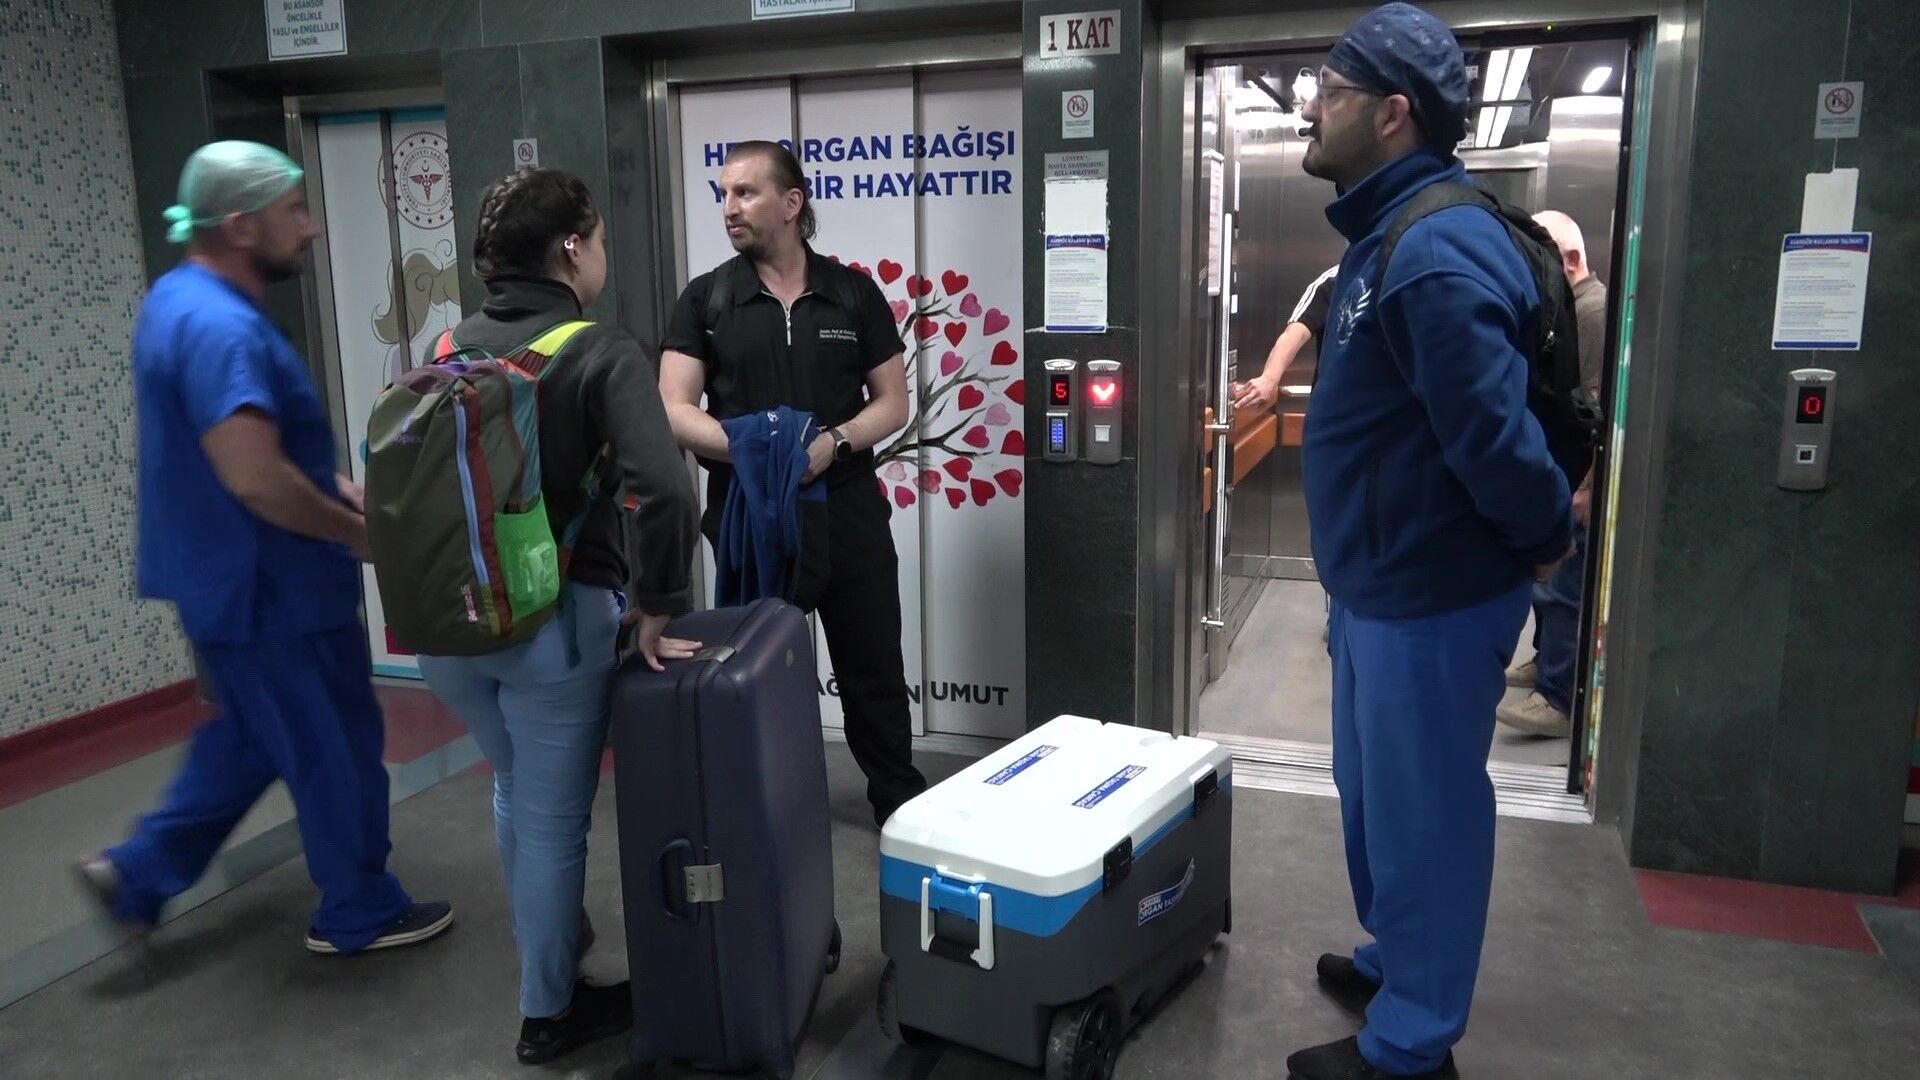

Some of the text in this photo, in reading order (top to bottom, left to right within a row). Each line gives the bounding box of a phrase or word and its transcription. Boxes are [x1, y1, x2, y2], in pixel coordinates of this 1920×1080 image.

[283, 2, 292, 10] BU
[1067, 17, 1114, 50] KAT
[903, 126, 1015, 161] BAĞIŞI
[853, 170, 1013, 198] HAYATTIR
[1055, 383, 1066, 398] 5
[1806, 397, 1820, 414] 0
[931, 681, 1009, 705] UMUT
